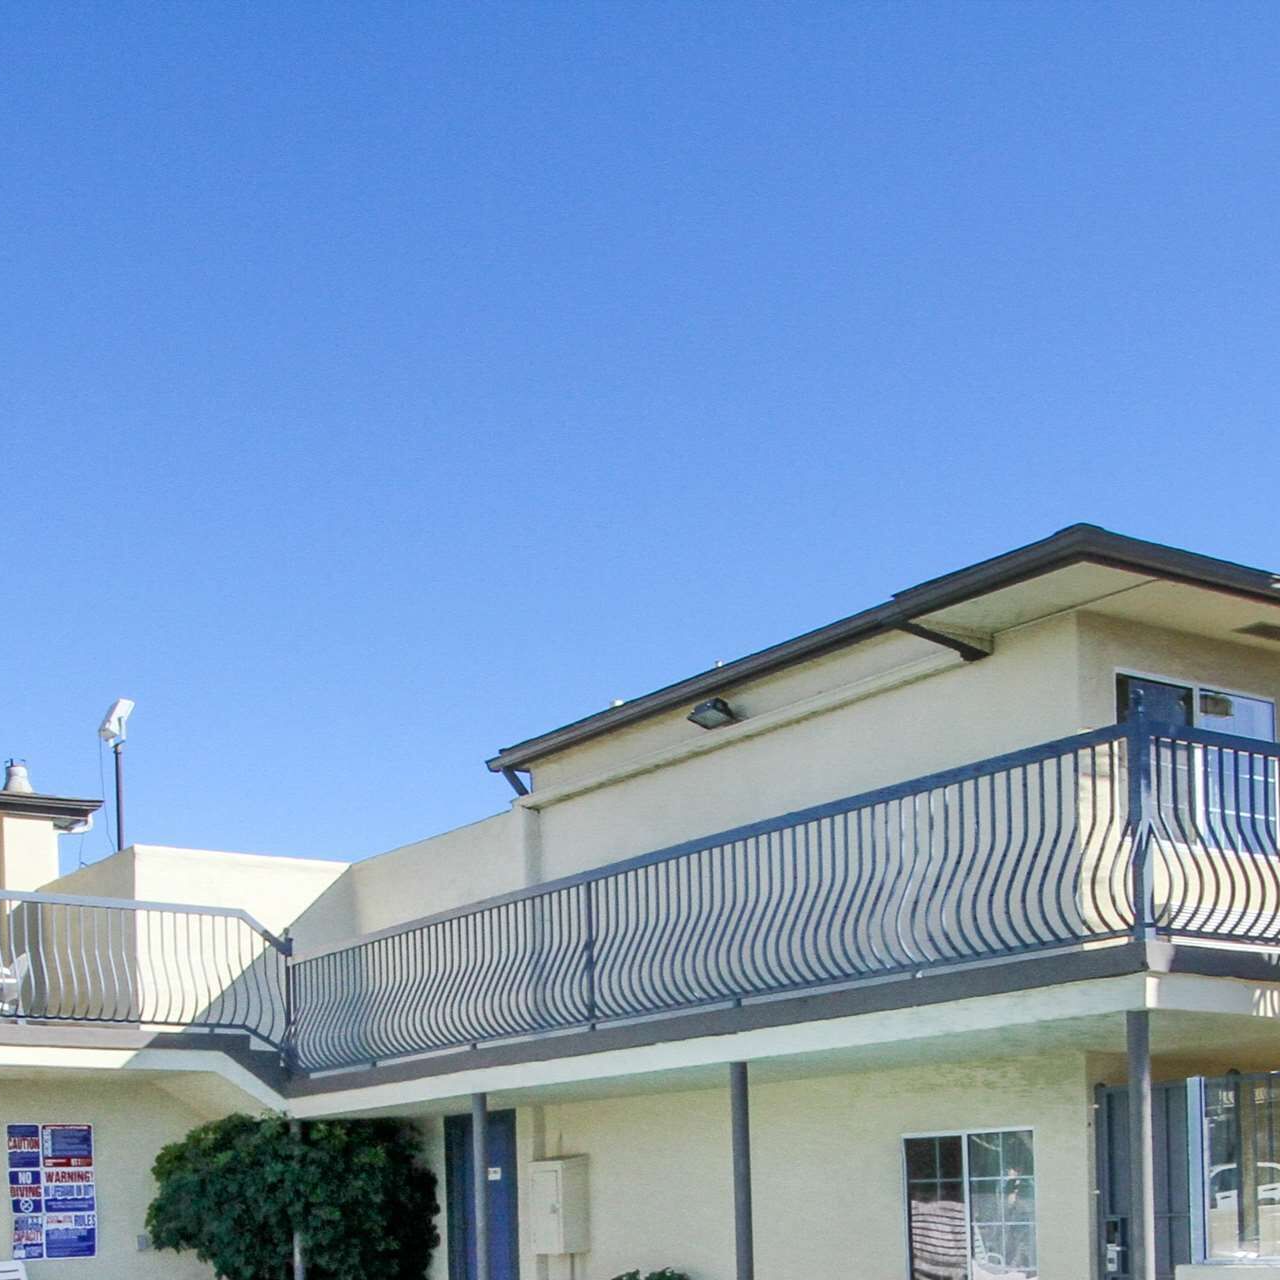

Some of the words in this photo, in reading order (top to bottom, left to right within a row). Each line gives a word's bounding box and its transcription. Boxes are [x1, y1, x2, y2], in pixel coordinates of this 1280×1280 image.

[18, 1172, 32, 1184] NO
[45, 1171, 94, 1183] WARNING!
[10, 1186, 42, 1197] DIVING
